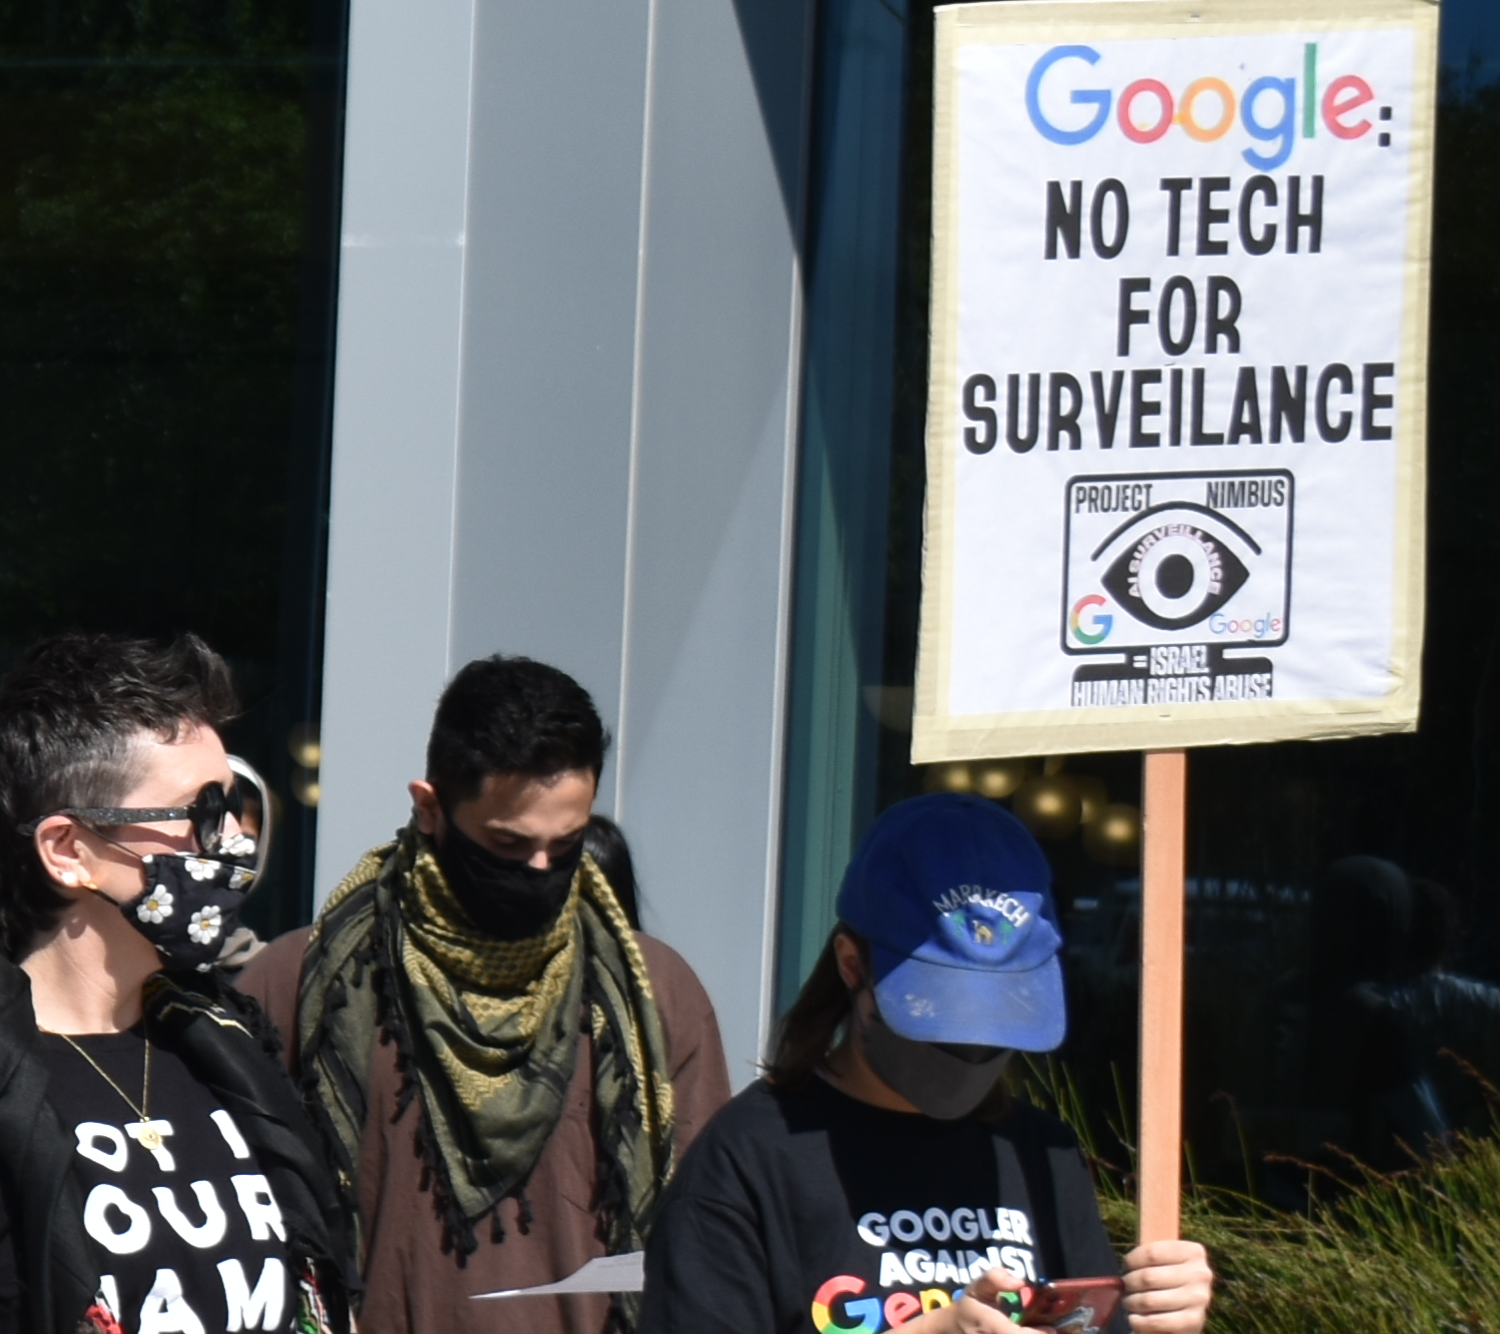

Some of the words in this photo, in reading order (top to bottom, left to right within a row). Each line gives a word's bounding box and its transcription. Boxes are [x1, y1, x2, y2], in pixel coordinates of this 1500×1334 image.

[1024, 42, 1393, 171] Google:
[1043, 178, 1130, 261] NO
[1160, 174, 1325, 257] TECH
[1116, 274, 1243, 357] FOR
[963, 362, 1396, 455] SURVEILANCE
[1075, 482, 1155, 514] PROJECT
[1206, 478, 1286, 509] NIMBUS
[1208, 612, 1282, 640] Google
[1149, 644, 1209, 676] ISRAEL
[1071, 677, 1145, 708] HUMAN
[1145, 674, 1212, 705] RIGHTS
[1212, 672, 1273, 702] ABUSE
[83, 1173, 288, 1256] OUR
[856, 1206, 1035, 1247] GOOGLER
[878, 1245, 1038, 1288] AGAINST
